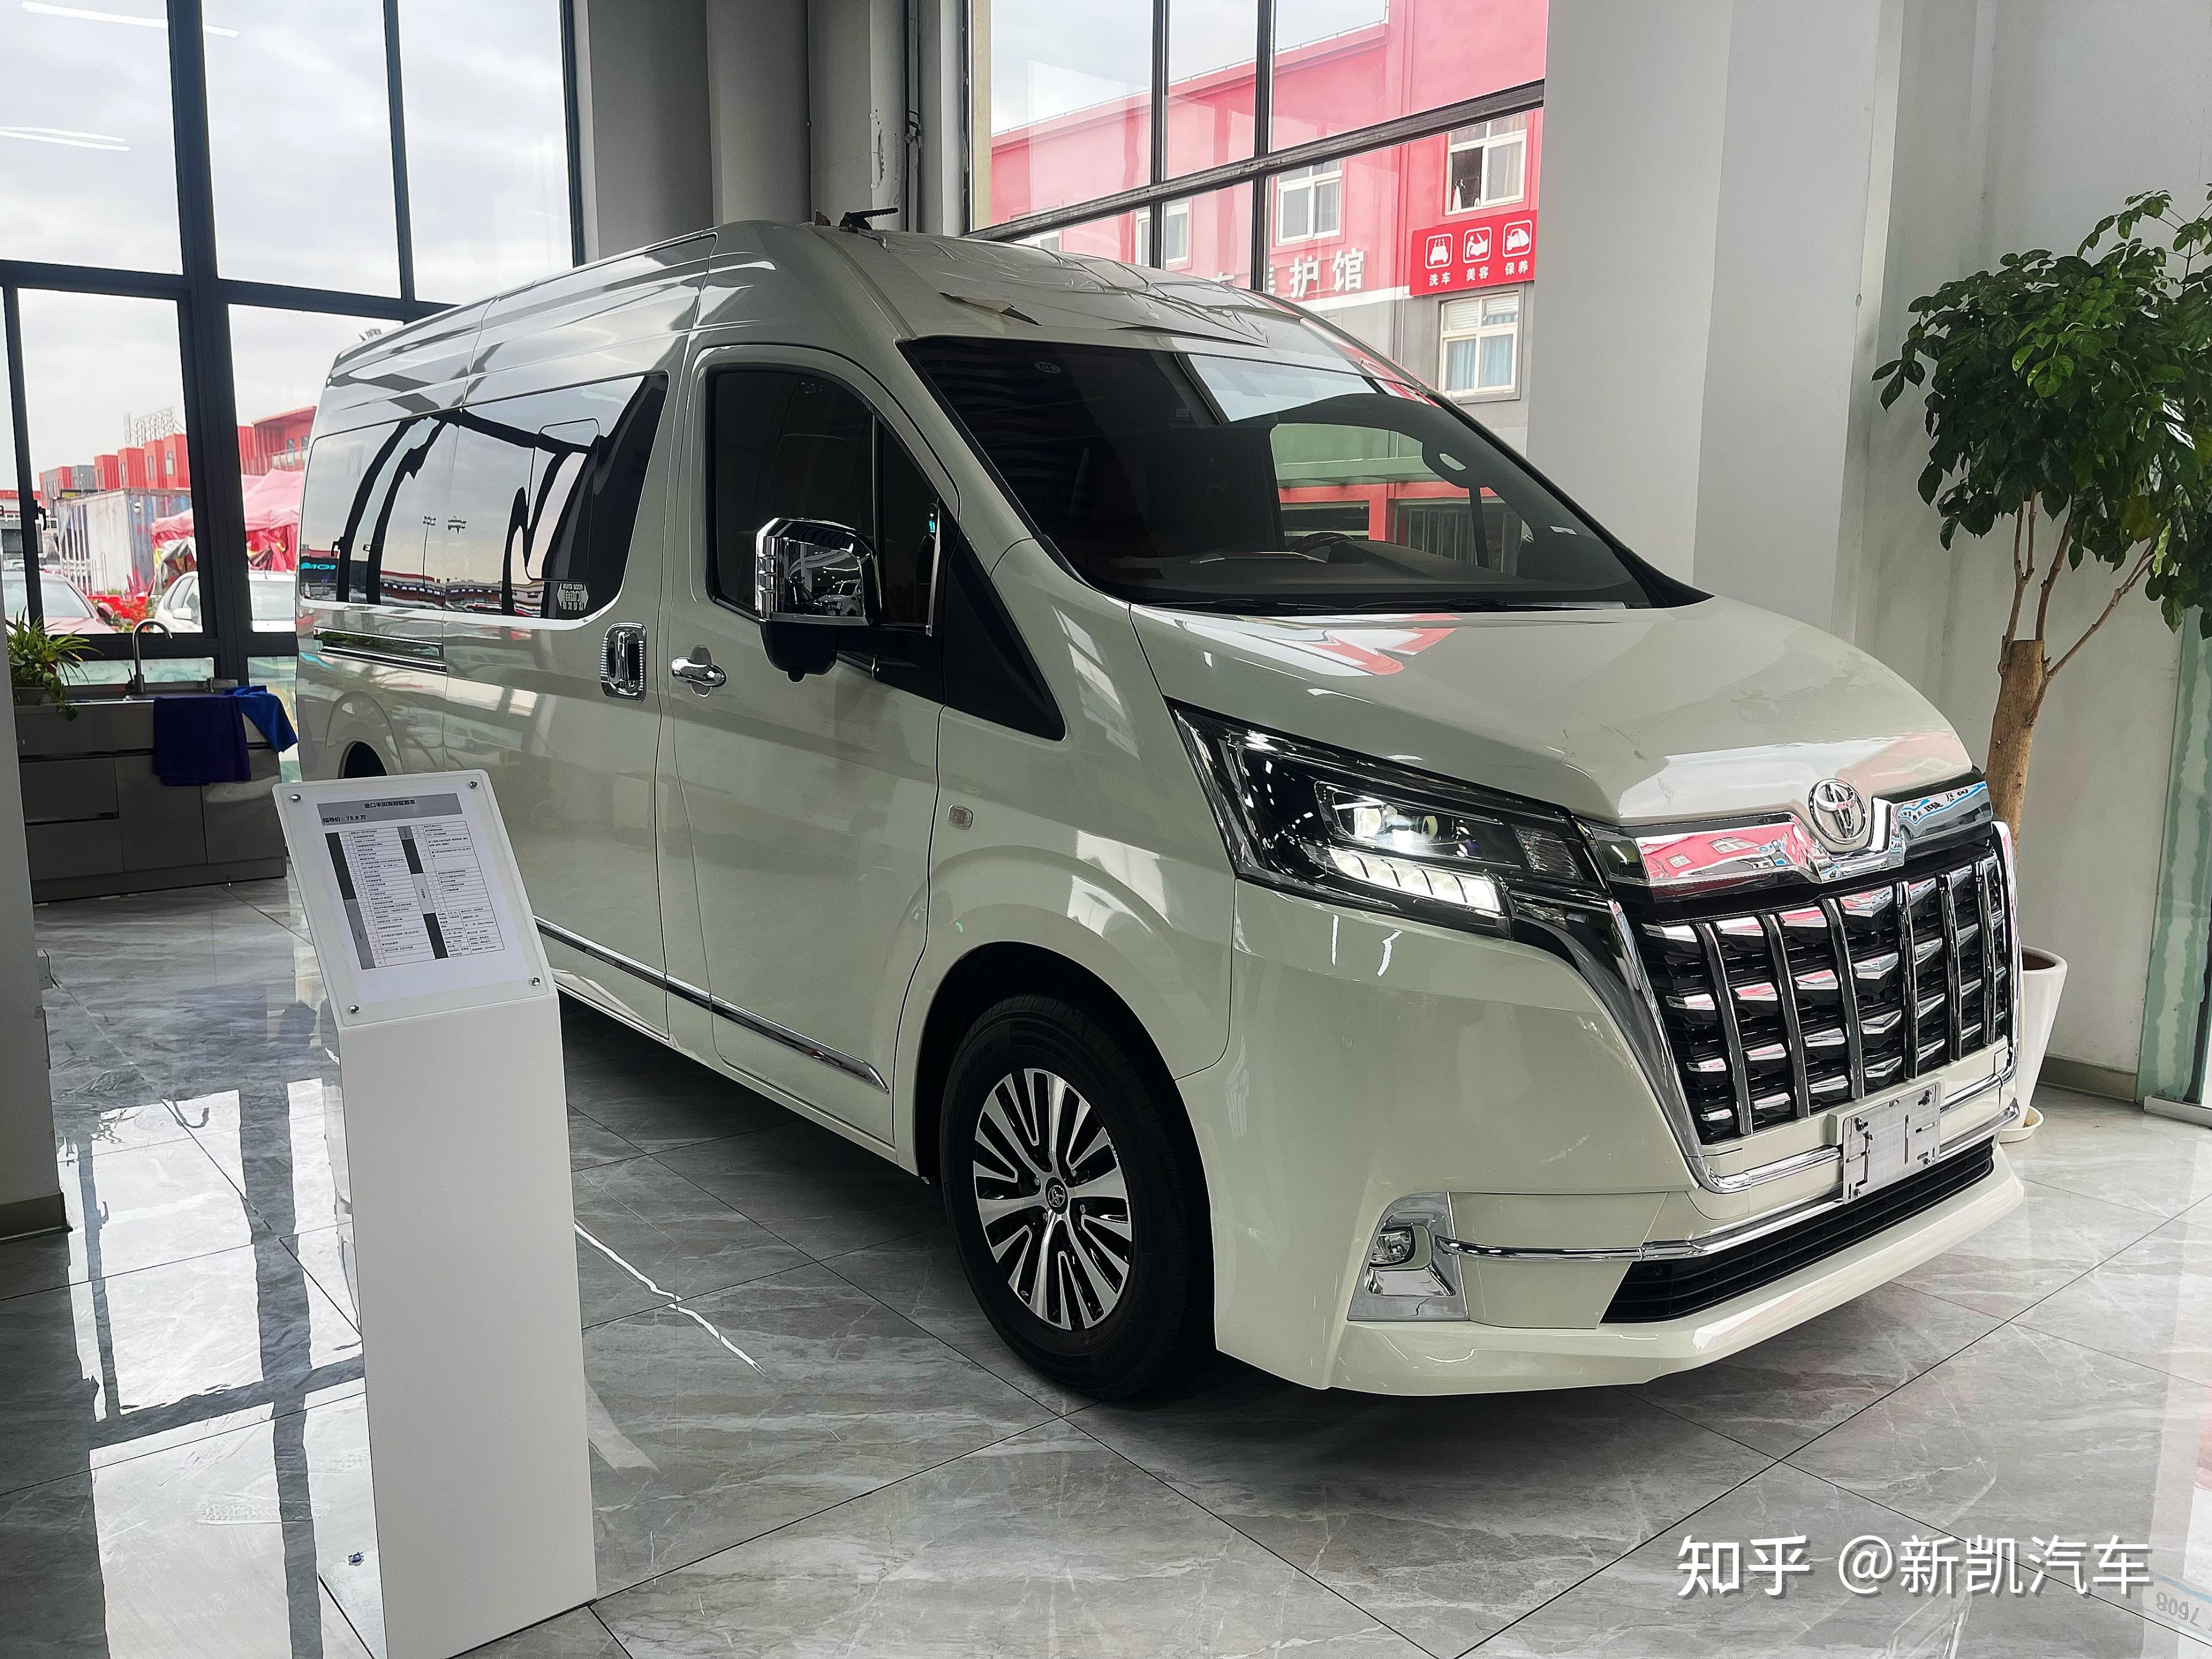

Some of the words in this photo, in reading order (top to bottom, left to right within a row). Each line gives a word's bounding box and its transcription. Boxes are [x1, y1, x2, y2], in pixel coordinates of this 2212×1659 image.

[1429, 272, 1451, 286] 洗车
[1466, 266, 1490, 282] 美容
[1504, 260, 1529, 276] 保养
